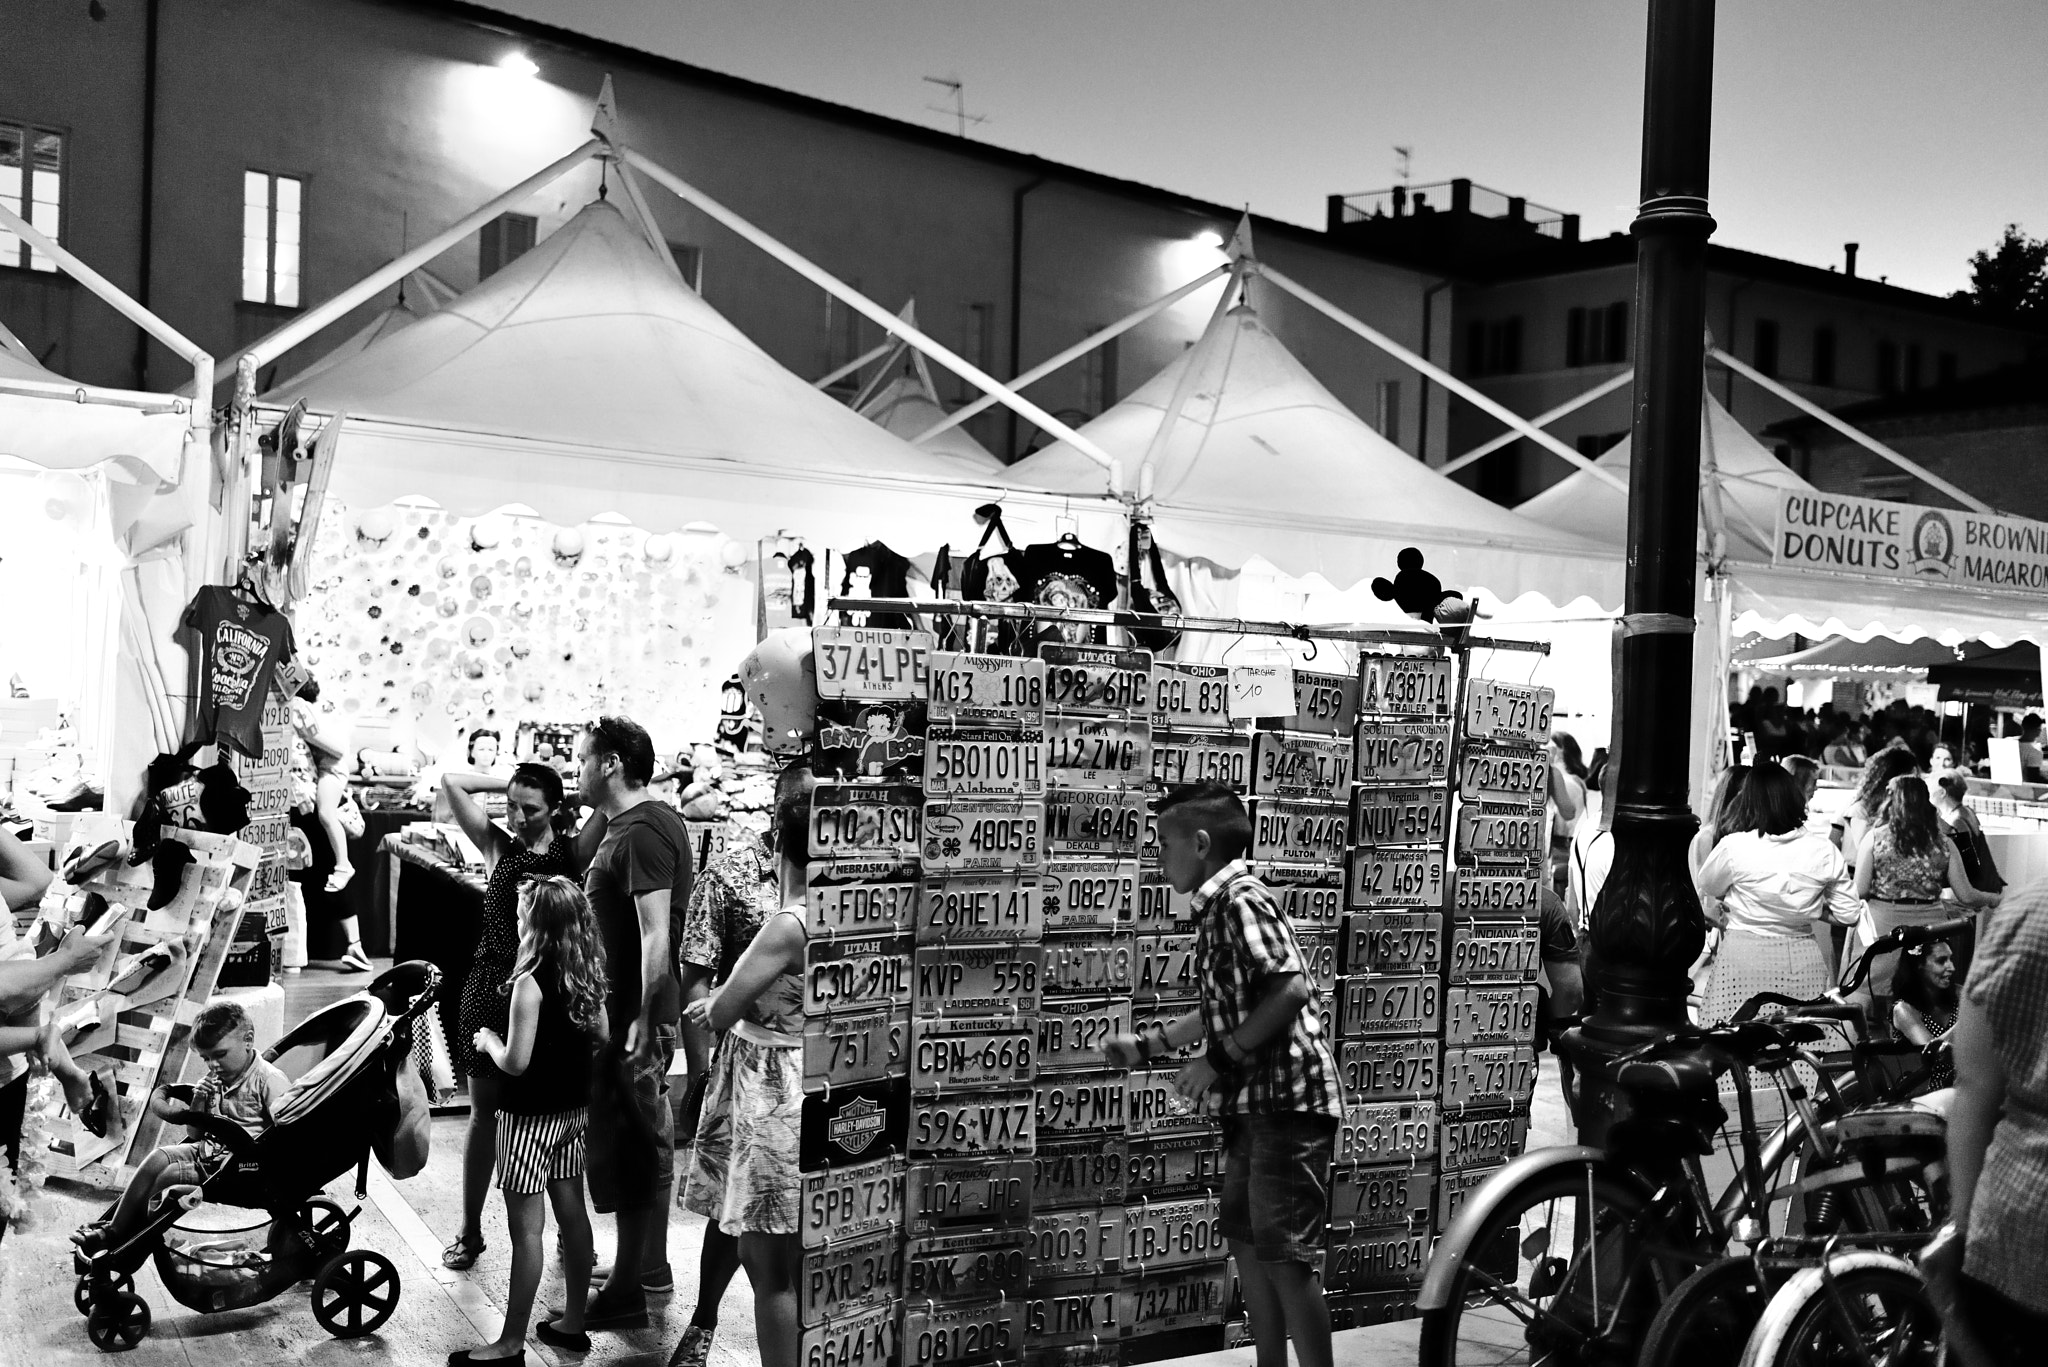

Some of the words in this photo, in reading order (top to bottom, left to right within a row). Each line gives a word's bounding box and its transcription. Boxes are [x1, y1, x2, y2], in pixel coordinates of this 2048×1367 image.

[1785, 495, 1900, 536] CUPCAKE
[1966, 520, 2048, 554] BROWNI
[1783, 532, 1900, 570] DONUTS
[217, 627, 268, 659] CALIFORNIA
[855, 631, 892, 645] OHIO
[822, 645, 868, 681] 374
[880, 646, 927, 683] LPE
[964, 657, 1013, 672] MISSISSIPPI
[1077, 651, 1117, 665] UTAH
[1190, 667, 1217, 678] OHIO
[1394, 661, 1425, 673] MAINE
[863, 681, 893, 692] ATHENS
[1046, 667, 1088, 701] A98
[1103, 671, 1147, 706] 6HC
[1294, 670, 1339, 688] labama
[933, 669, 974, 702] KG3
[1002, 674, 1041, 707] 108
[1384, 671, 1446, 704] 438714
[1497, 688, 1532, 699] TRAILER
[1306, 686, 1343, 719] 459
[1389, 702, 1428, 714] TRAILER
[956, 706, 1017, 720] LAUDERDALE
[1152, 715, 1165, 725] 31
[1508, 698, 1549, 731] 7316
[961, 731, 982, 742] Stars
[983, 731, 998, 742] Fell
[999, 733, 1012, 742] On
[1363, 724, 1395, 735] SOUTH
[1404, 725, 1449, 736] CAROLINA
[1492, 727, 1527, 738] WYOMING
[935, 744, 1039, 779] 5B0101H
[1047, 736, 1085, 768] 112
[1091, 740, 1133, 771] ZWG
[1489, 749, 1530, 760] INDIANA
[1535, 753, 1547, 762] 79
[1083, 771, 1097, 780] LEE
[1467, 757, 1544, 792] 73A9532
[161, 783, 196, 807] ROUTE
[953, 781, 1015, 794] Alabama
[850, 790, 888, 802] UTAH
[1388, 793, 1420, 803] Virginia
[1433, 792, 1443, 801] 89
[952, 803, 1018, 814] KENTUCKY
[1482, 805, 1524, 816] INDIANA
[1092, 806, 1139, 841] 4846
[1361, 804, 1442, 838] NUV-594
[969, 819, 1024, 852] 4805
[1258, 815, 1290, 846] BUX
[1302, 816, 1345, 849] 0446
[1066, 841, 1100, 851] DEKALB
[1143, 847, 1159, 858] NOV
[1283, 849, 1316, 858] FULTON
[836, 863, 890, 875] NEBRASKA
[964, 858, 1002, 869] FARM
[1051, 863, 1114, 874] KENTUCKY
[1275, 869, 1320, 879] NEBRASKA
[1361, 862, 1383, 895] 42
[1392, 862, 1424, 895] 469
[1460, 868, 1471, 877] 81
[1476, 868, 1523, 878] INDIANA
[1068, 878, 1120, 910] 0827
[1457, 880, 1538, 910] 55A5234
[929, 890, 1029, 927] 28HE141
[1139, 886, 1178, 920] DAL
[1062, 915, 1098, 926] FARM
[1384, 915, 1412, 927] OHIO
[1475, 929, 1519, 939] INDIANA
[1526, 930, 1538, 938] 80
[844, 941, 881, 955] UTAH
[1064, 941, 1093, 949] TRUCK
[1354, 928, 1437, 962] PMS-375
[948, 949, 1011, 969] MISSISSIPPI
[1454, 940, 1537, 970] 99D5717
[813, 963, 854, 1001] C30
[869, 957, 907, 994] 9HL
[1140, 953, 1171, 989] AZ
[919, 963, 964, 998] KVP
[992, 961, 1037, 993] 558
[1177, 989, 1197, 998] CRISP
[1477, 992, 1513, 1002] TRAILER
[944, 998, 1010, 1009] LAUDERDALE
[1061, 1003, 1089, 1013] OHIO
[1349, 986, 1377, 1022] HP
[1383, 985, 1436, 1019] 6718
[1487, 1001, 1532, 1030] 7318
[949, 1020, 1004, 1031] Kentucky
[1361, 1018, 1423, 1030] MASSACHUSETTS
[1472, 1031, 1509, 1041] WYOMING
[829, 1031, 869, 1072] 751
[888, 1026, 901, 1058] S
[918, 1039, 966, 1074] CBN
[982, 1037, 1031, 1070] 668
[1346, 1046, 1359, 1058] KY
[1422, 1042, 1435, 1055] KY
[1473, 1053, 1508, 1063] TRAILER
[949, 1075, 981, 1085] Bluegrass
[983, 1074, 1000, 1082] State
[1345, 1058, 1433, 1091] 3DE-975
[1485, 1061, 1529, 1093] 7317
[1075, 1085, 1124, 1122] PNH
[1469, 1092, 1504, 1102] WYOMING
[833, 1114, 881, 1133] HARLEY-DAVIDSON
[916, 1109, 967, 1145] S96
[980, 1105, 1029, 1142] VXZ
[1150, 1115, 1208, 1129] LAUDERDALE
[1153, 1138, 1202, 1150] KENTUCKY
[1341, 1122, 1428, 1157] BS3-159
[1448, 1118, 1519, 1155] 5A4958L
[835, 1165, 882, 1183] FLORIDA
[943, 1168, 993, 1183] Kentucky
[1127, 1153, 1168, 1185] 931
[918, 1182, 962, 1214] 104
[979, 1178, 1022, 1210] JHC
[1153, 1184, 1199, 1195] CUMBERLAND
[1356, 1179, 1408, 1212] 7835
[811, 1184, 854, 1229] SPB
[1126, 1211, 1141, 1226] KY
[1357, 1211, 1403, 1223] INDIANA
[834, 1218, 880, 1235] VOLUSIA
[834, 1240, 881, 1259] FLORIDA
[942, 1235, 996, 1249] Kentucky
[911, 1257, 959, 1292] BXK
[975, 1250, 1024, 1283] 880
[811, 1263, 853, 1308] PXR
[1134, 1287, 1170, 1322] 732
[934, 1307, 997, 1323] KENTUCKY
[1053, 1294, 1097, 1333] TRK
[1164, 1317, 1177, 1326] LEE
[829, 1315, 881, 1337] KENTUCKY
[918, 1319, 1012, 1363] 081205
